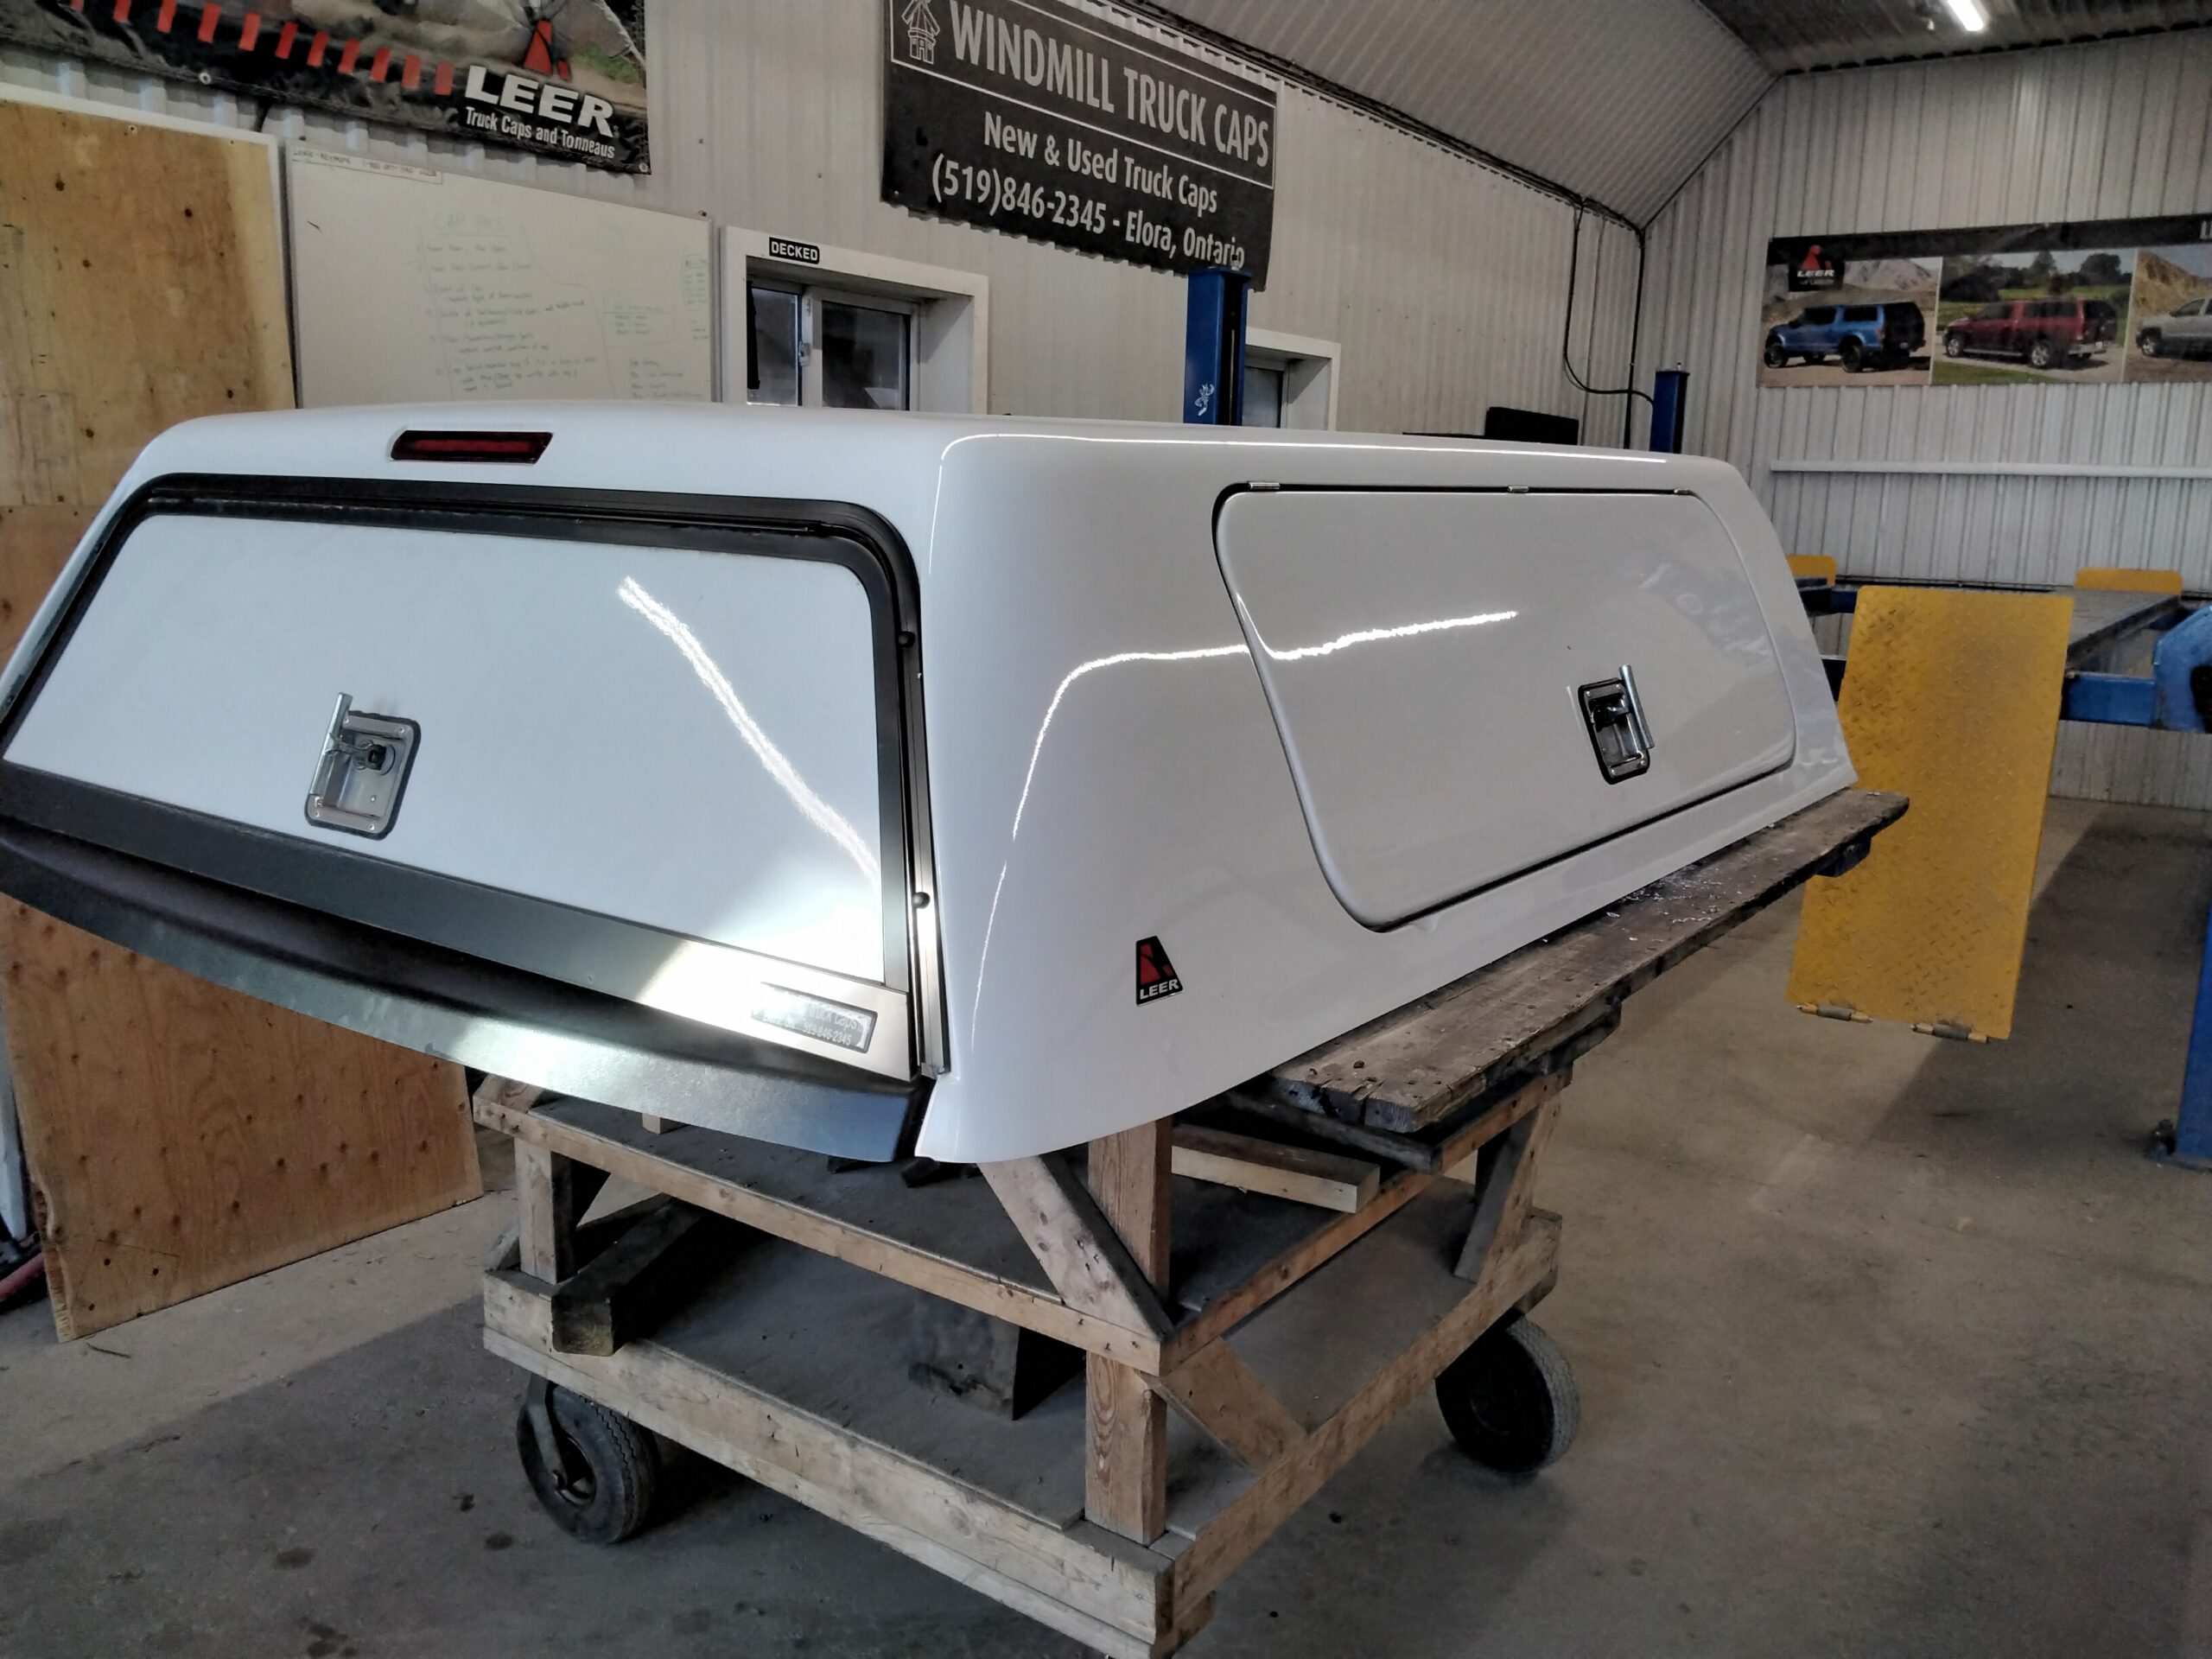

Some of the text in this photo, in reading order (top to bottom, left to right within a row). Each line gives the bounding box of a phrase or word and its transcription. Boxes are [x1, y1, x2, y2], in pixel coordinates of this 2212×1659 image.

[465, 65, 613, 137] LEER
[950, 3, 1269, 168] WINDMILL TRUCK CAPS
[466, 106, 615, 159] Truck Caps and Tonneaus
[985, 111, 1217, 218] New & Used Truck Caps
[932, 154, 1107, 234] (519)846-2345
[1126, 211, 1177, 258] Elora,
[1184, 227, 1245, 269] Ontario
[771, 241, 818, 261] DECKED
[1140, 978, 1179, 1000] LEER
